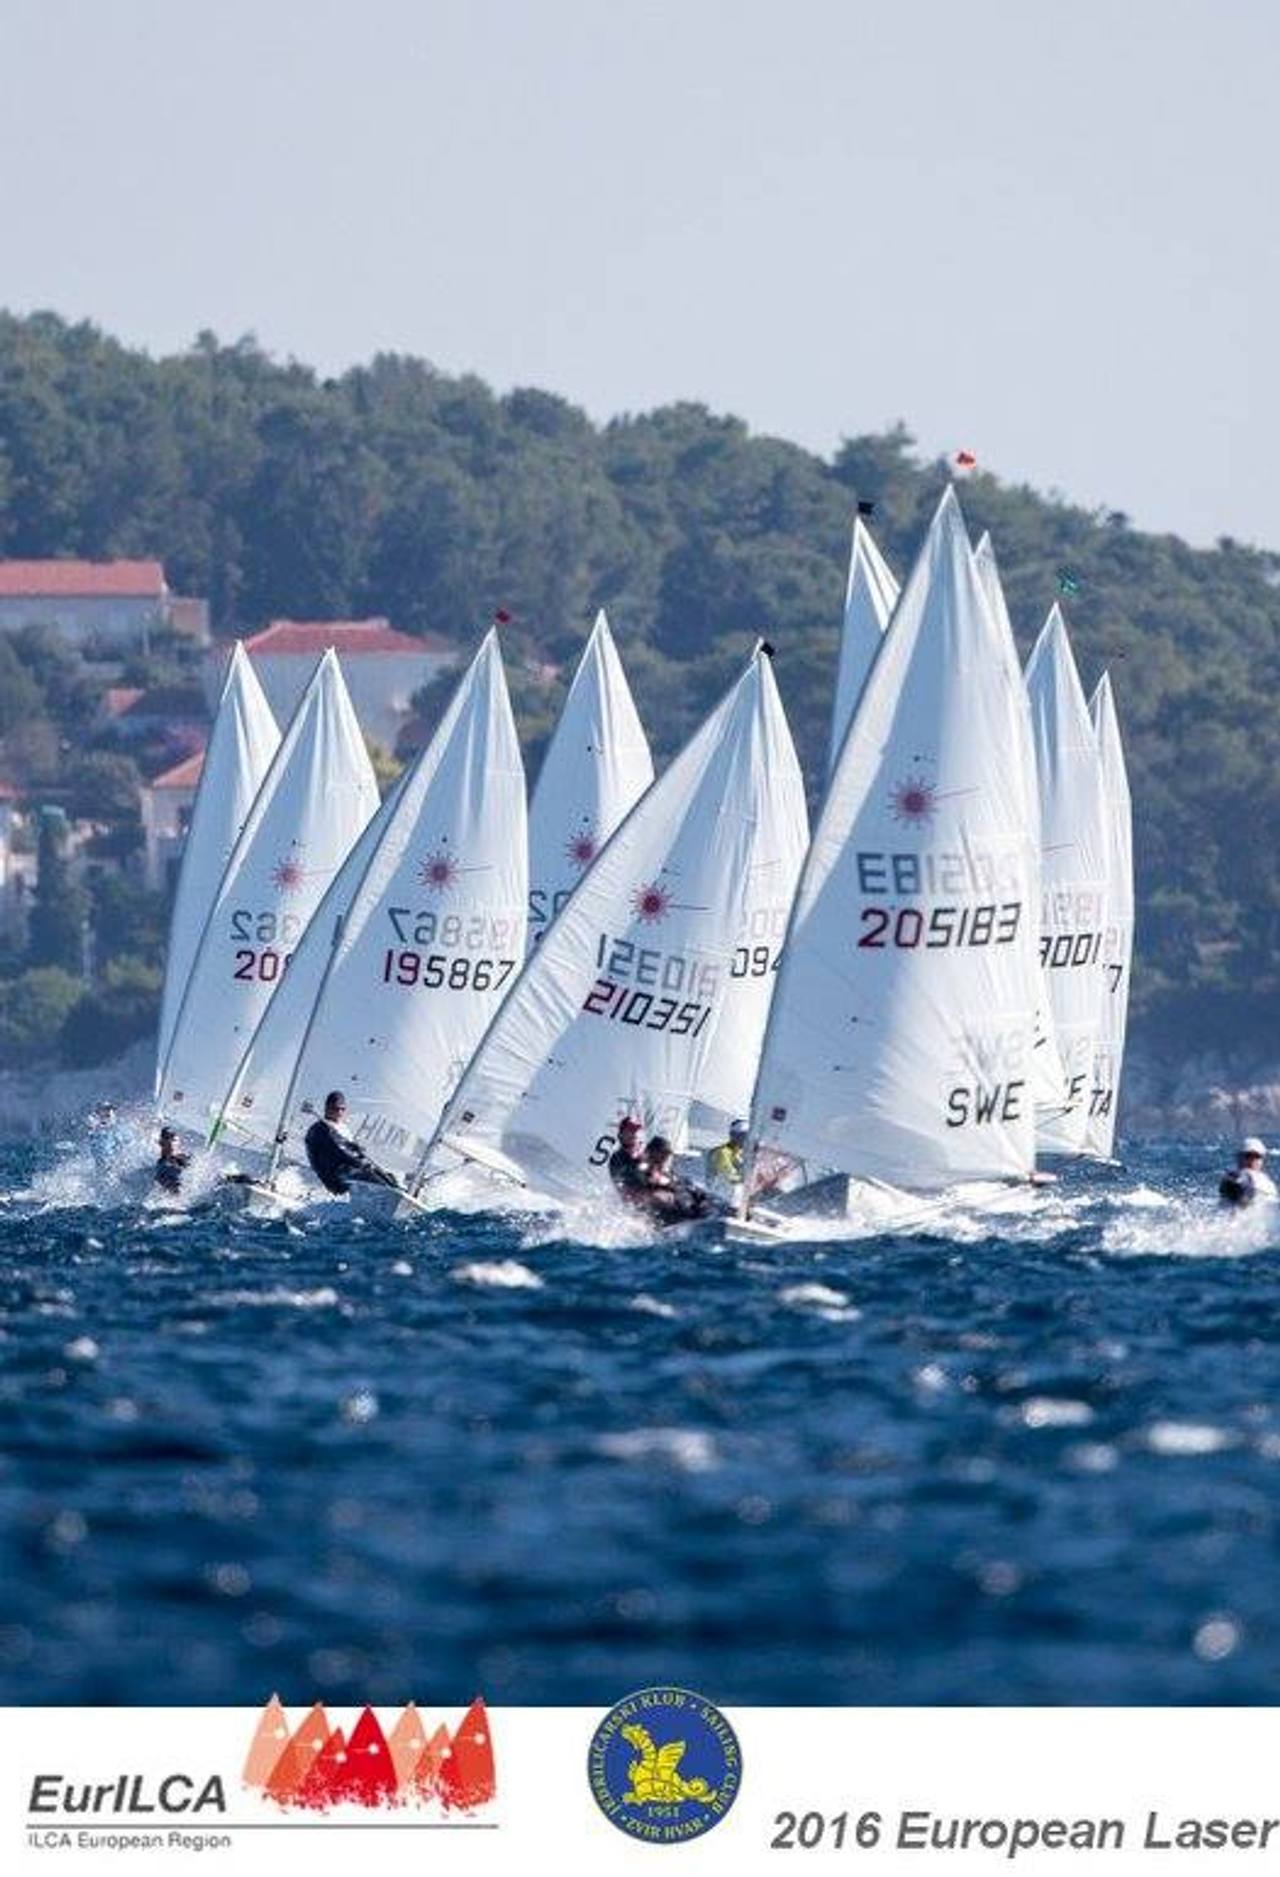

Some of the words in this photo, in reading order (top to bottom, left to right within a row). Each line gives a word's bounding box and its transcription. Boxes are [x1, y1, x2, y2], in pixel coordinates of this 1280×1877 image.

[858, 902, 1021, 948] 205183
[383, 949, 516, 991] 195867
[582, 979, 711, 1037] 210351
[946, 1079, 1025, 1127] SWE
